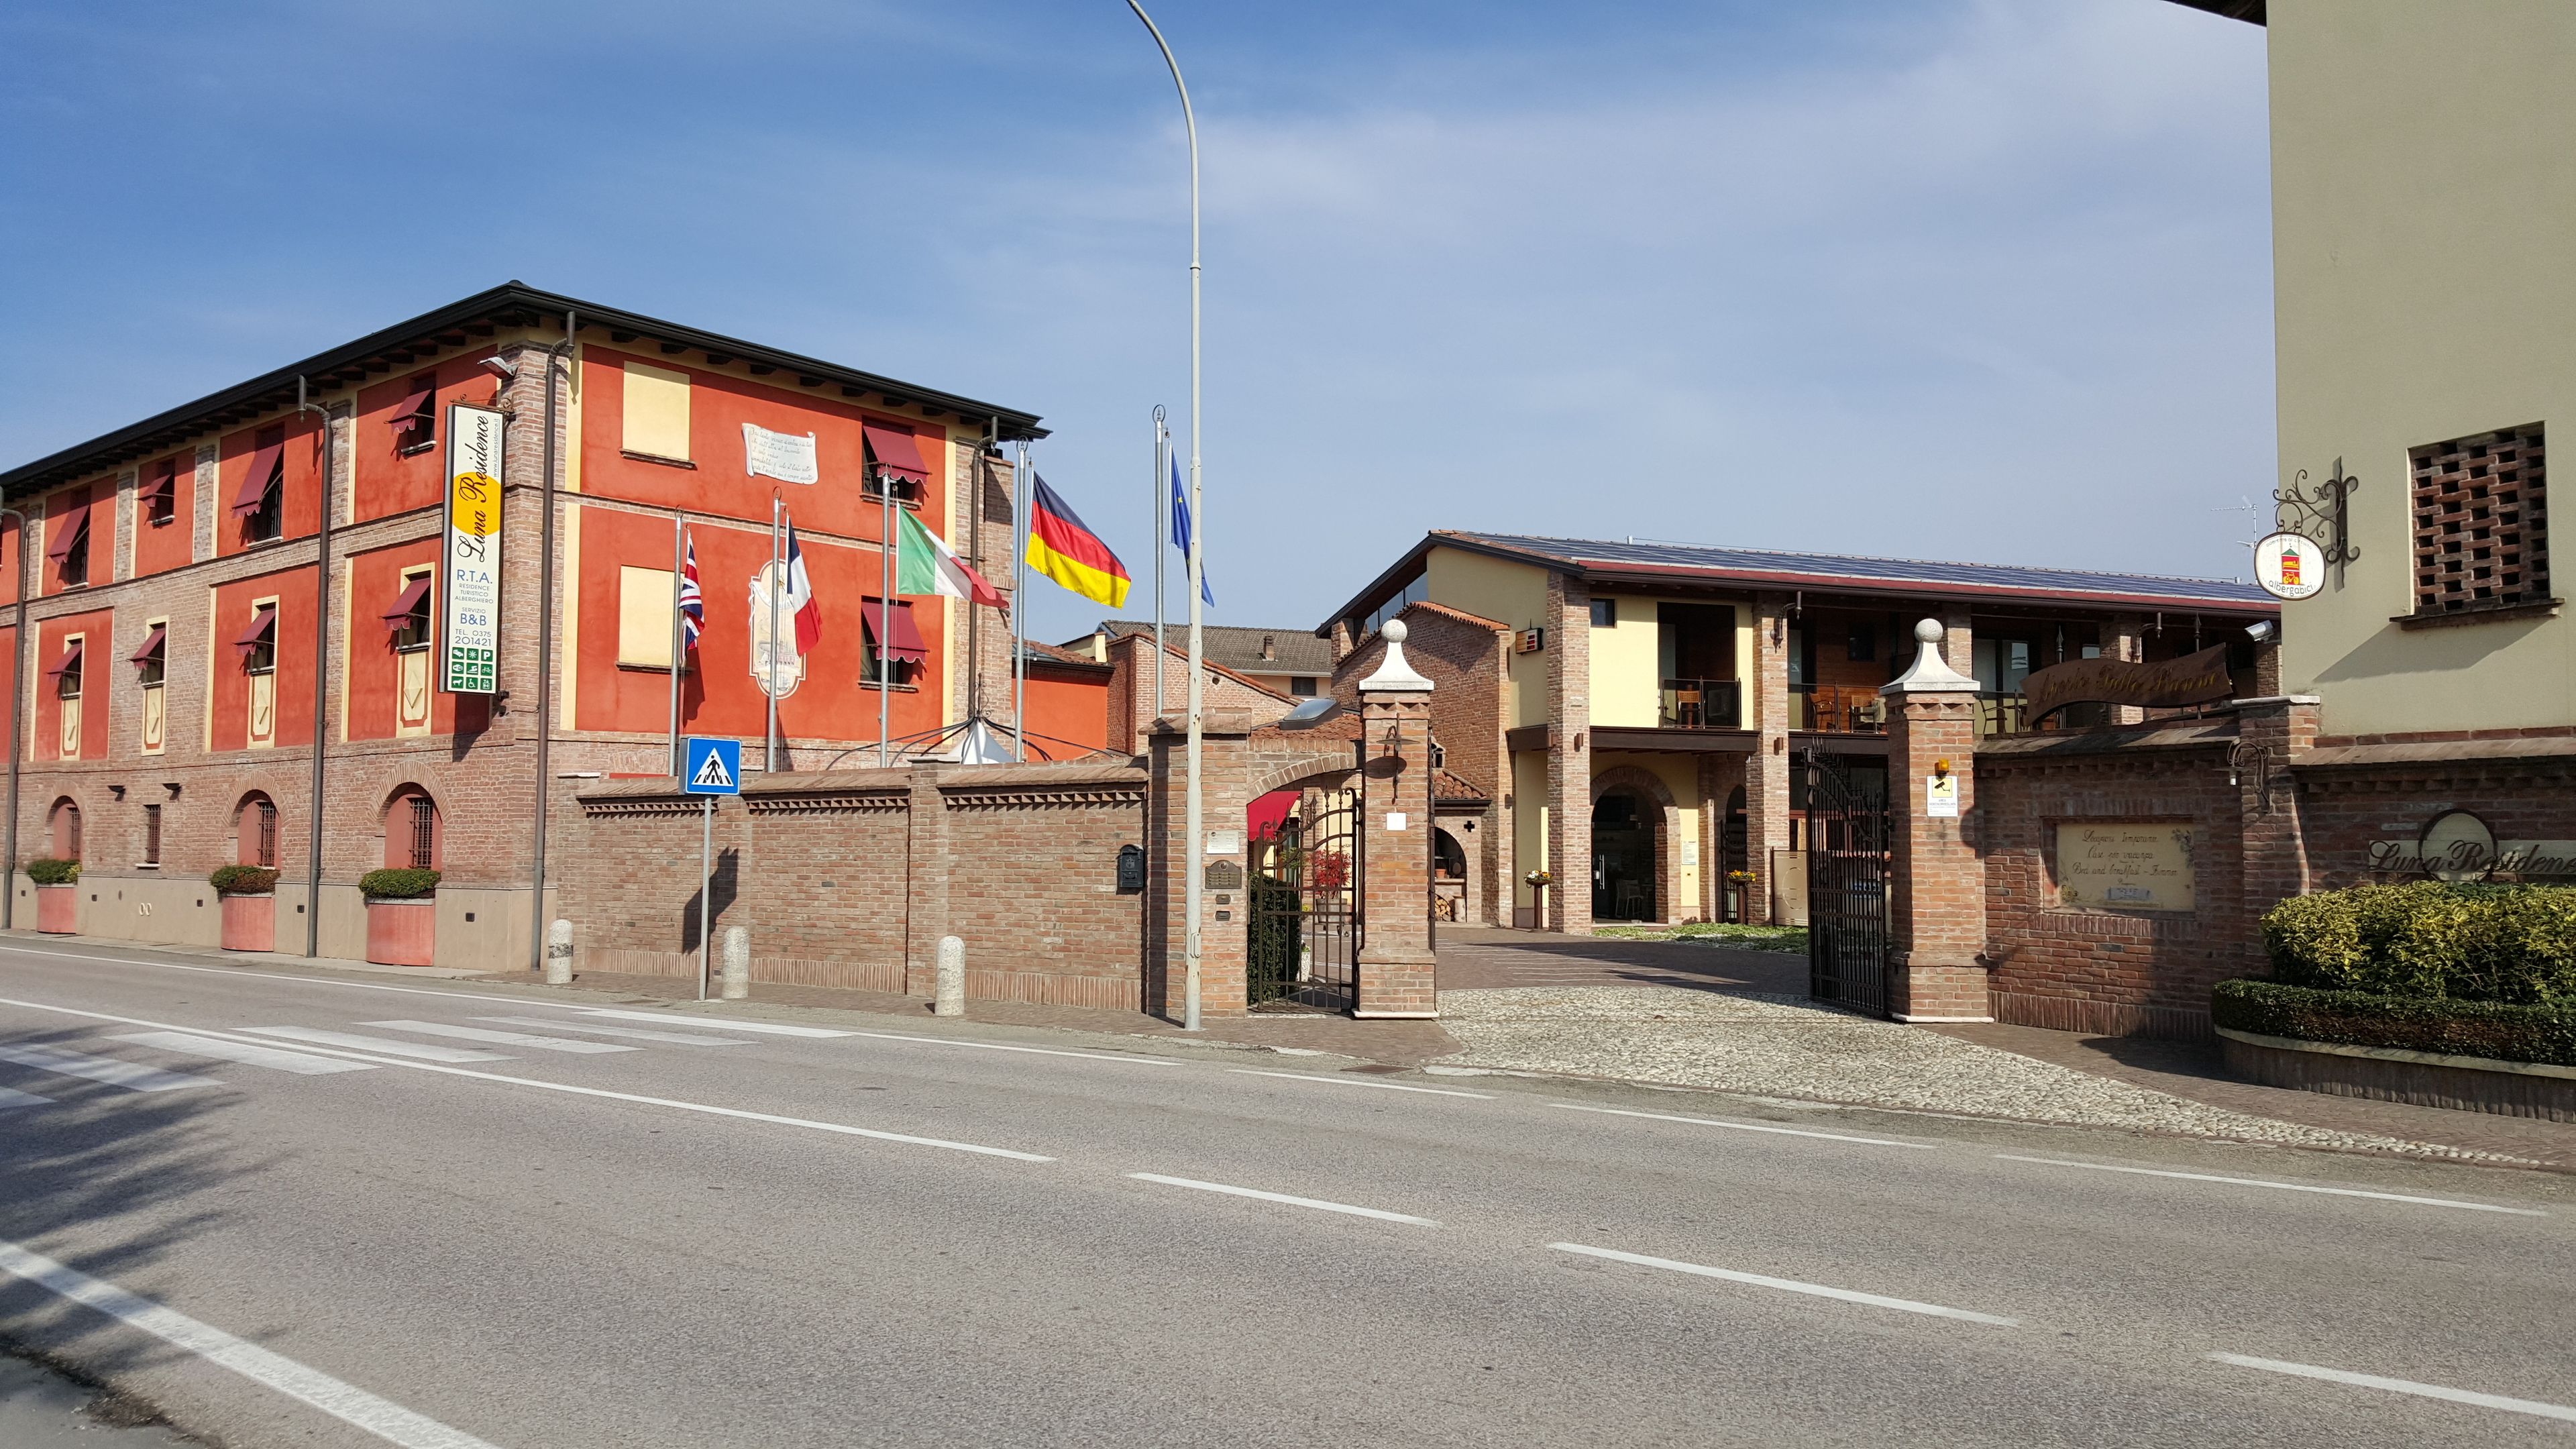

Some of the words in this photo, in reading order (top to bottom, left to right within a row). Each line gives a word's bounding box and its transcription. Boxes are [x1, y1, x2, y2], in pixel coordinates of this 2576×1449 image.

[459, 416, 488, 503] Residence
[458, 510, 486, 562] Luna
[457, 569, 492, 584] R.T.A.
[459, 583, 490, 591] RESIDENCE
[2269, 580, 2314, 596] albergabici
[455, 596, 494, 604] ALBERGHIERO
[460, 613, 486, 626] B&B
[455, 636, 491, 646] 201421
[2369, 840, 2445, 872] Luna
